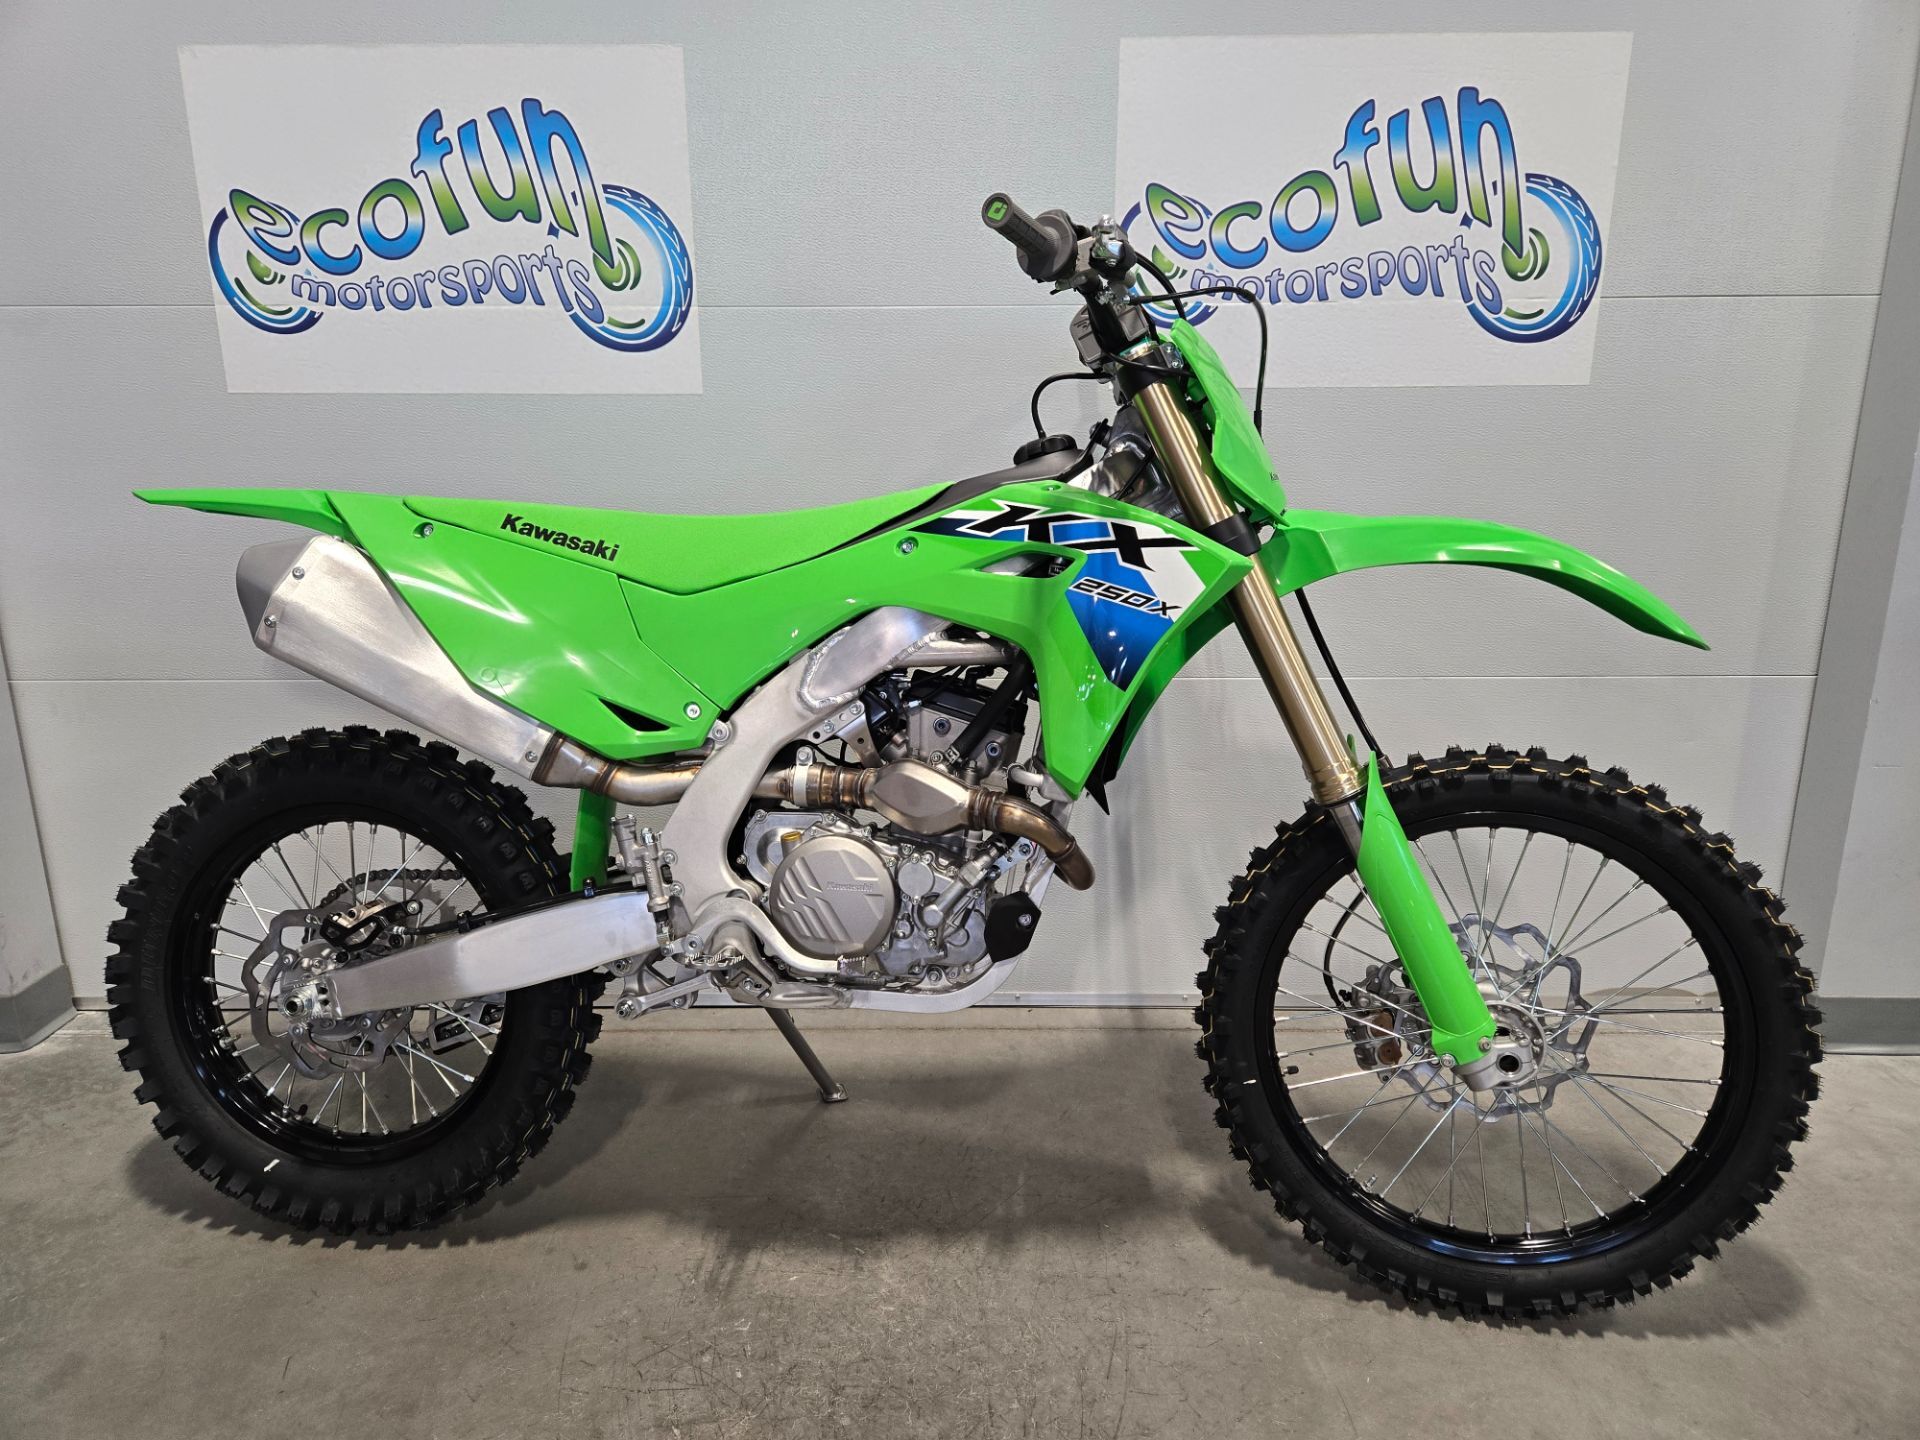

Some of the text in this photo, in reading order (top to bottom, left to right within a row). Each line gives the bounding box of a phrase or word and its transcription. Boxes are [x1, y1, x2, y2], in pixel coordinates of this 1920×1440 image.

[229, 98, 614, 275] ecofun
[1146, 87, 1523, 269] ecofun
[292, 245, 605, 324] motorsports
[1191, 235, 1503, 316] motorsports
[500, 513, 620, 562] Kawasaki
[957, 499, 1199, 572] KX
